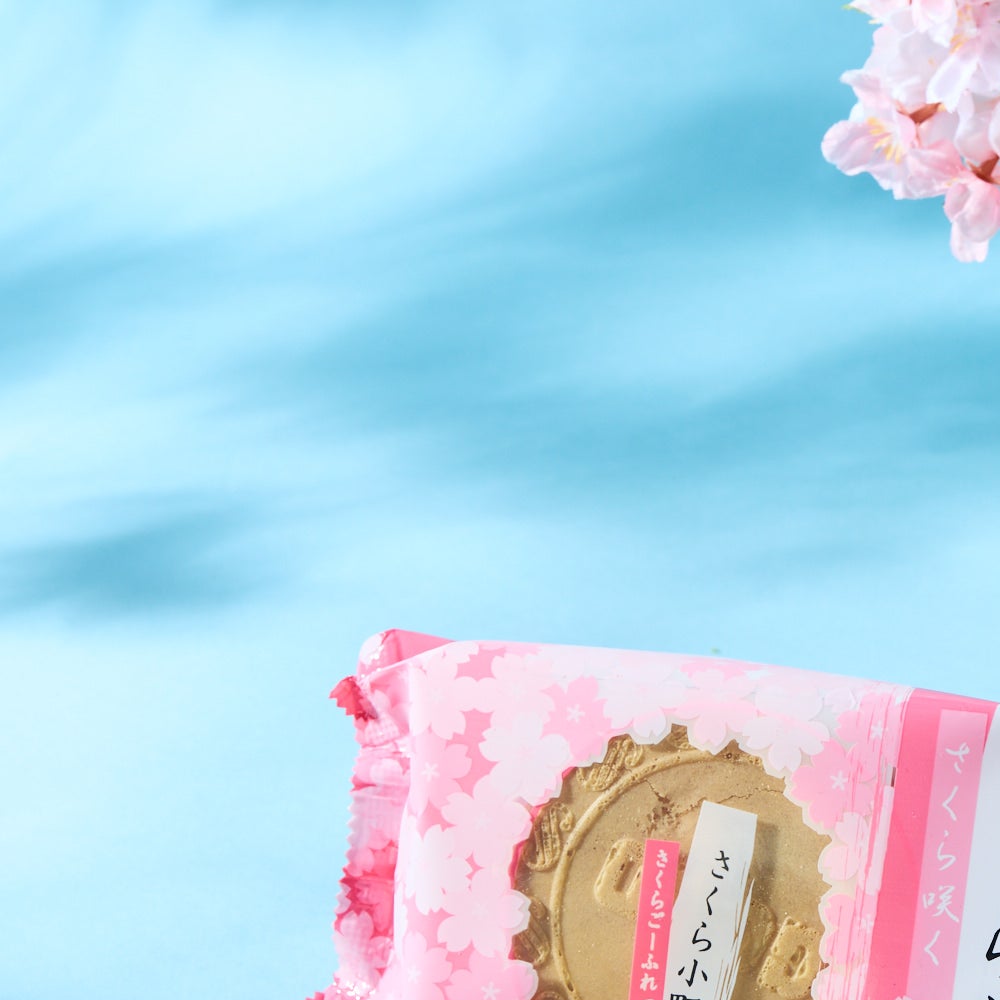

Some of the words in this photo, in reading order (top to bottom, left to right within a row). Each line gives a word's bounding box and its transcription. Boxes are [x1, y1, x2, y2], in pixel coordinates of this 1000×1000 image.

[922, 741, 972, 967] さくら咲く
